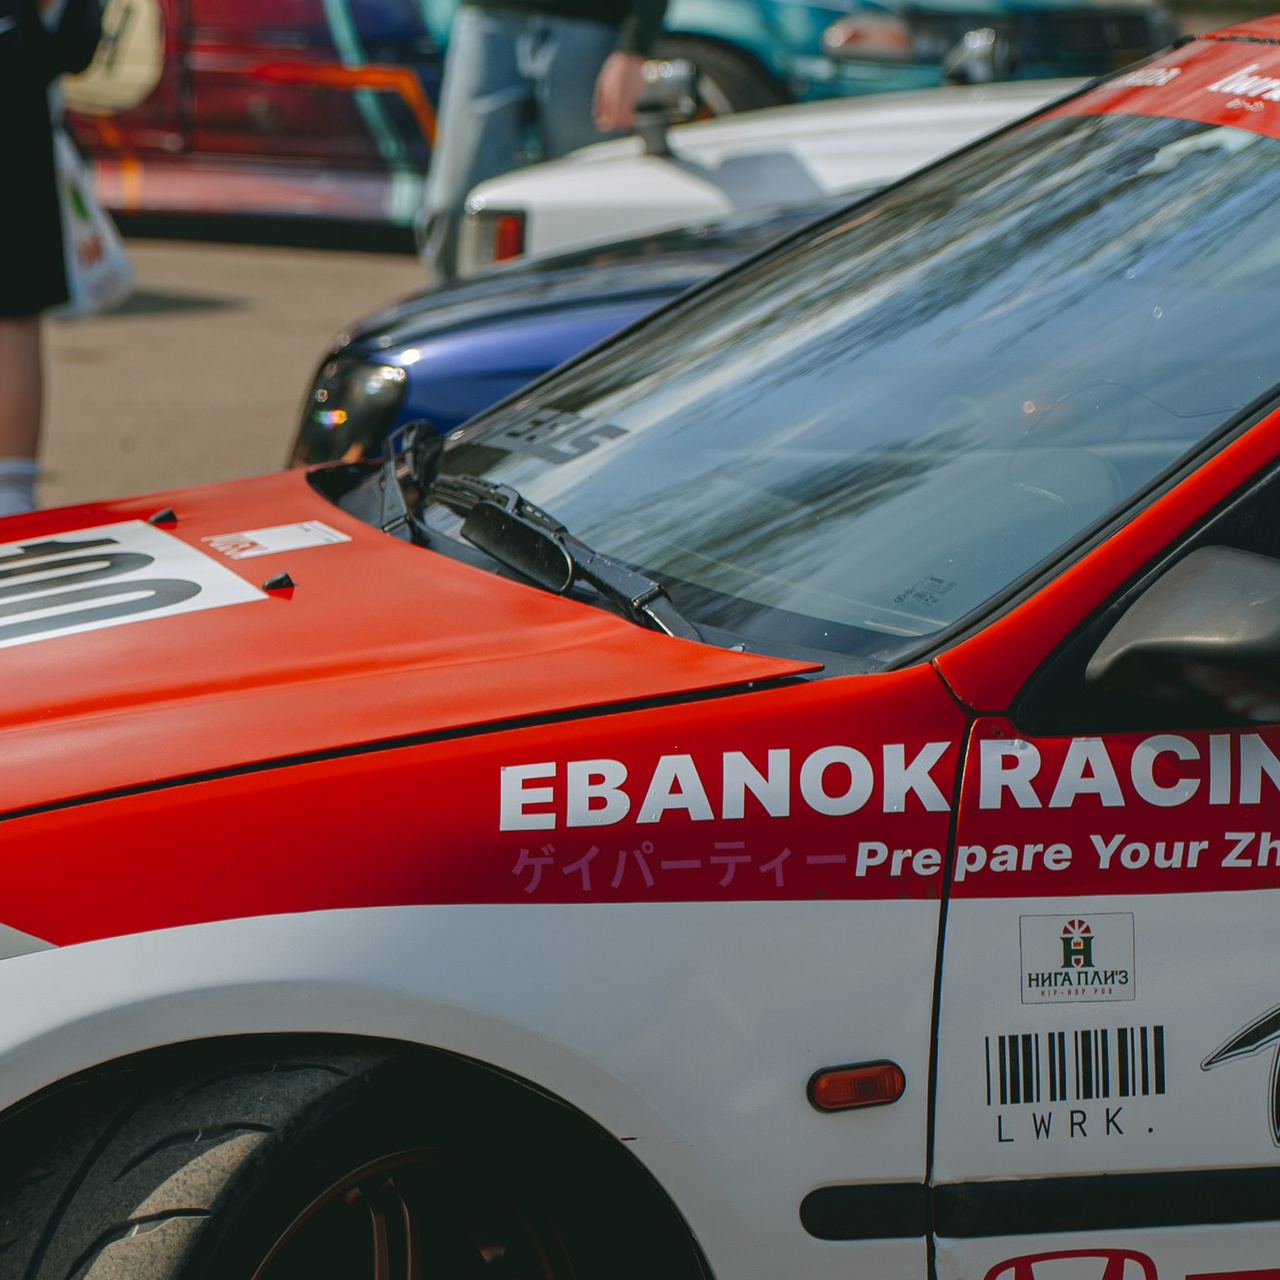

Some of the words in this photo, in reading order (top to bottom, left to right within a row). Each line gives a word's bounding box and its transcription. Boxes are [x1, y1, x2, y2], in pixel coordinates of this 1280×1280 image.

[499, 740, 952, 832] EBANOK
[510, 840, 847, 894] ゲイパーティー
[1089, 833, 1209, 870] Your
[1027, 971, 1073, 988] НИГА
[1040, 988, 1086, 997] HIP-HOP
[1093, 987, 1113, 995] PUB
